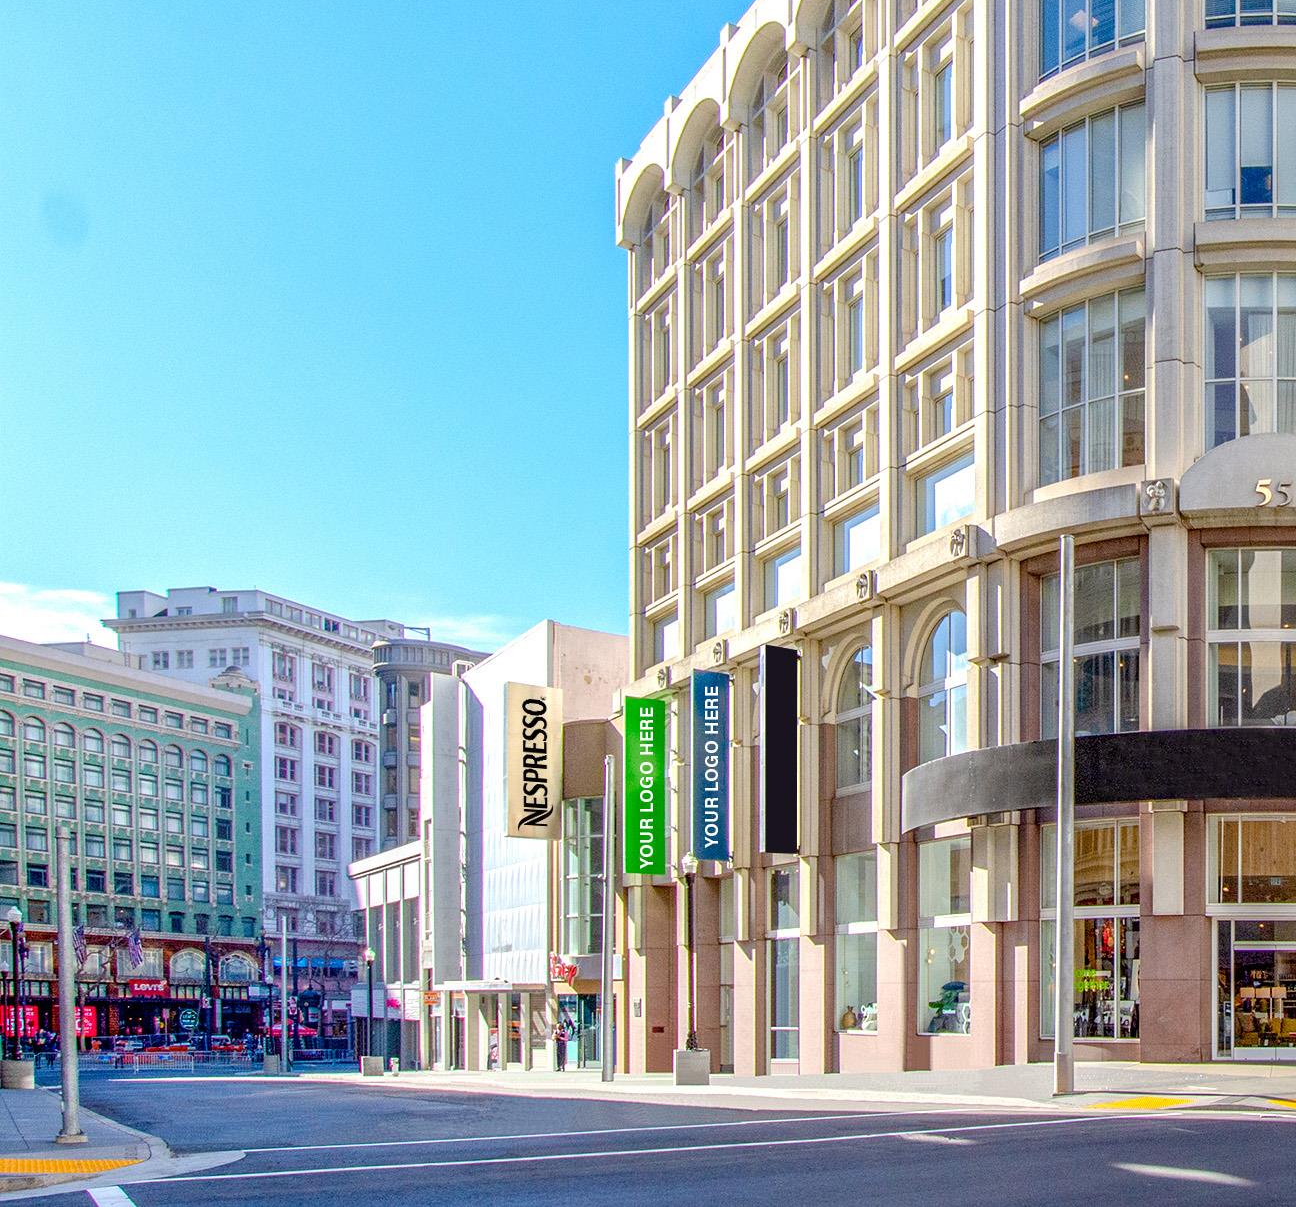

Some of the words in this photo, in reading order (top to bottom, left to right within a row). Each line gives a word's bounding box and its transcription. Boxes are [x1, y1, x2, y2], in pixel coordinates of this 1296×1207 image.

[1255, 479, 1292, 507] 55
[640, 706, 654, 755] HERE
[705, 686, 719, 734] HERE
[518, 698, 553, 831] NESPRESSO
[640, 761, 654, 812] LOGO
[705, 740, 719, 791] LOGO
[640, 818, 654, 869] YOUR
[705, 797, 719, 848] YOUR
